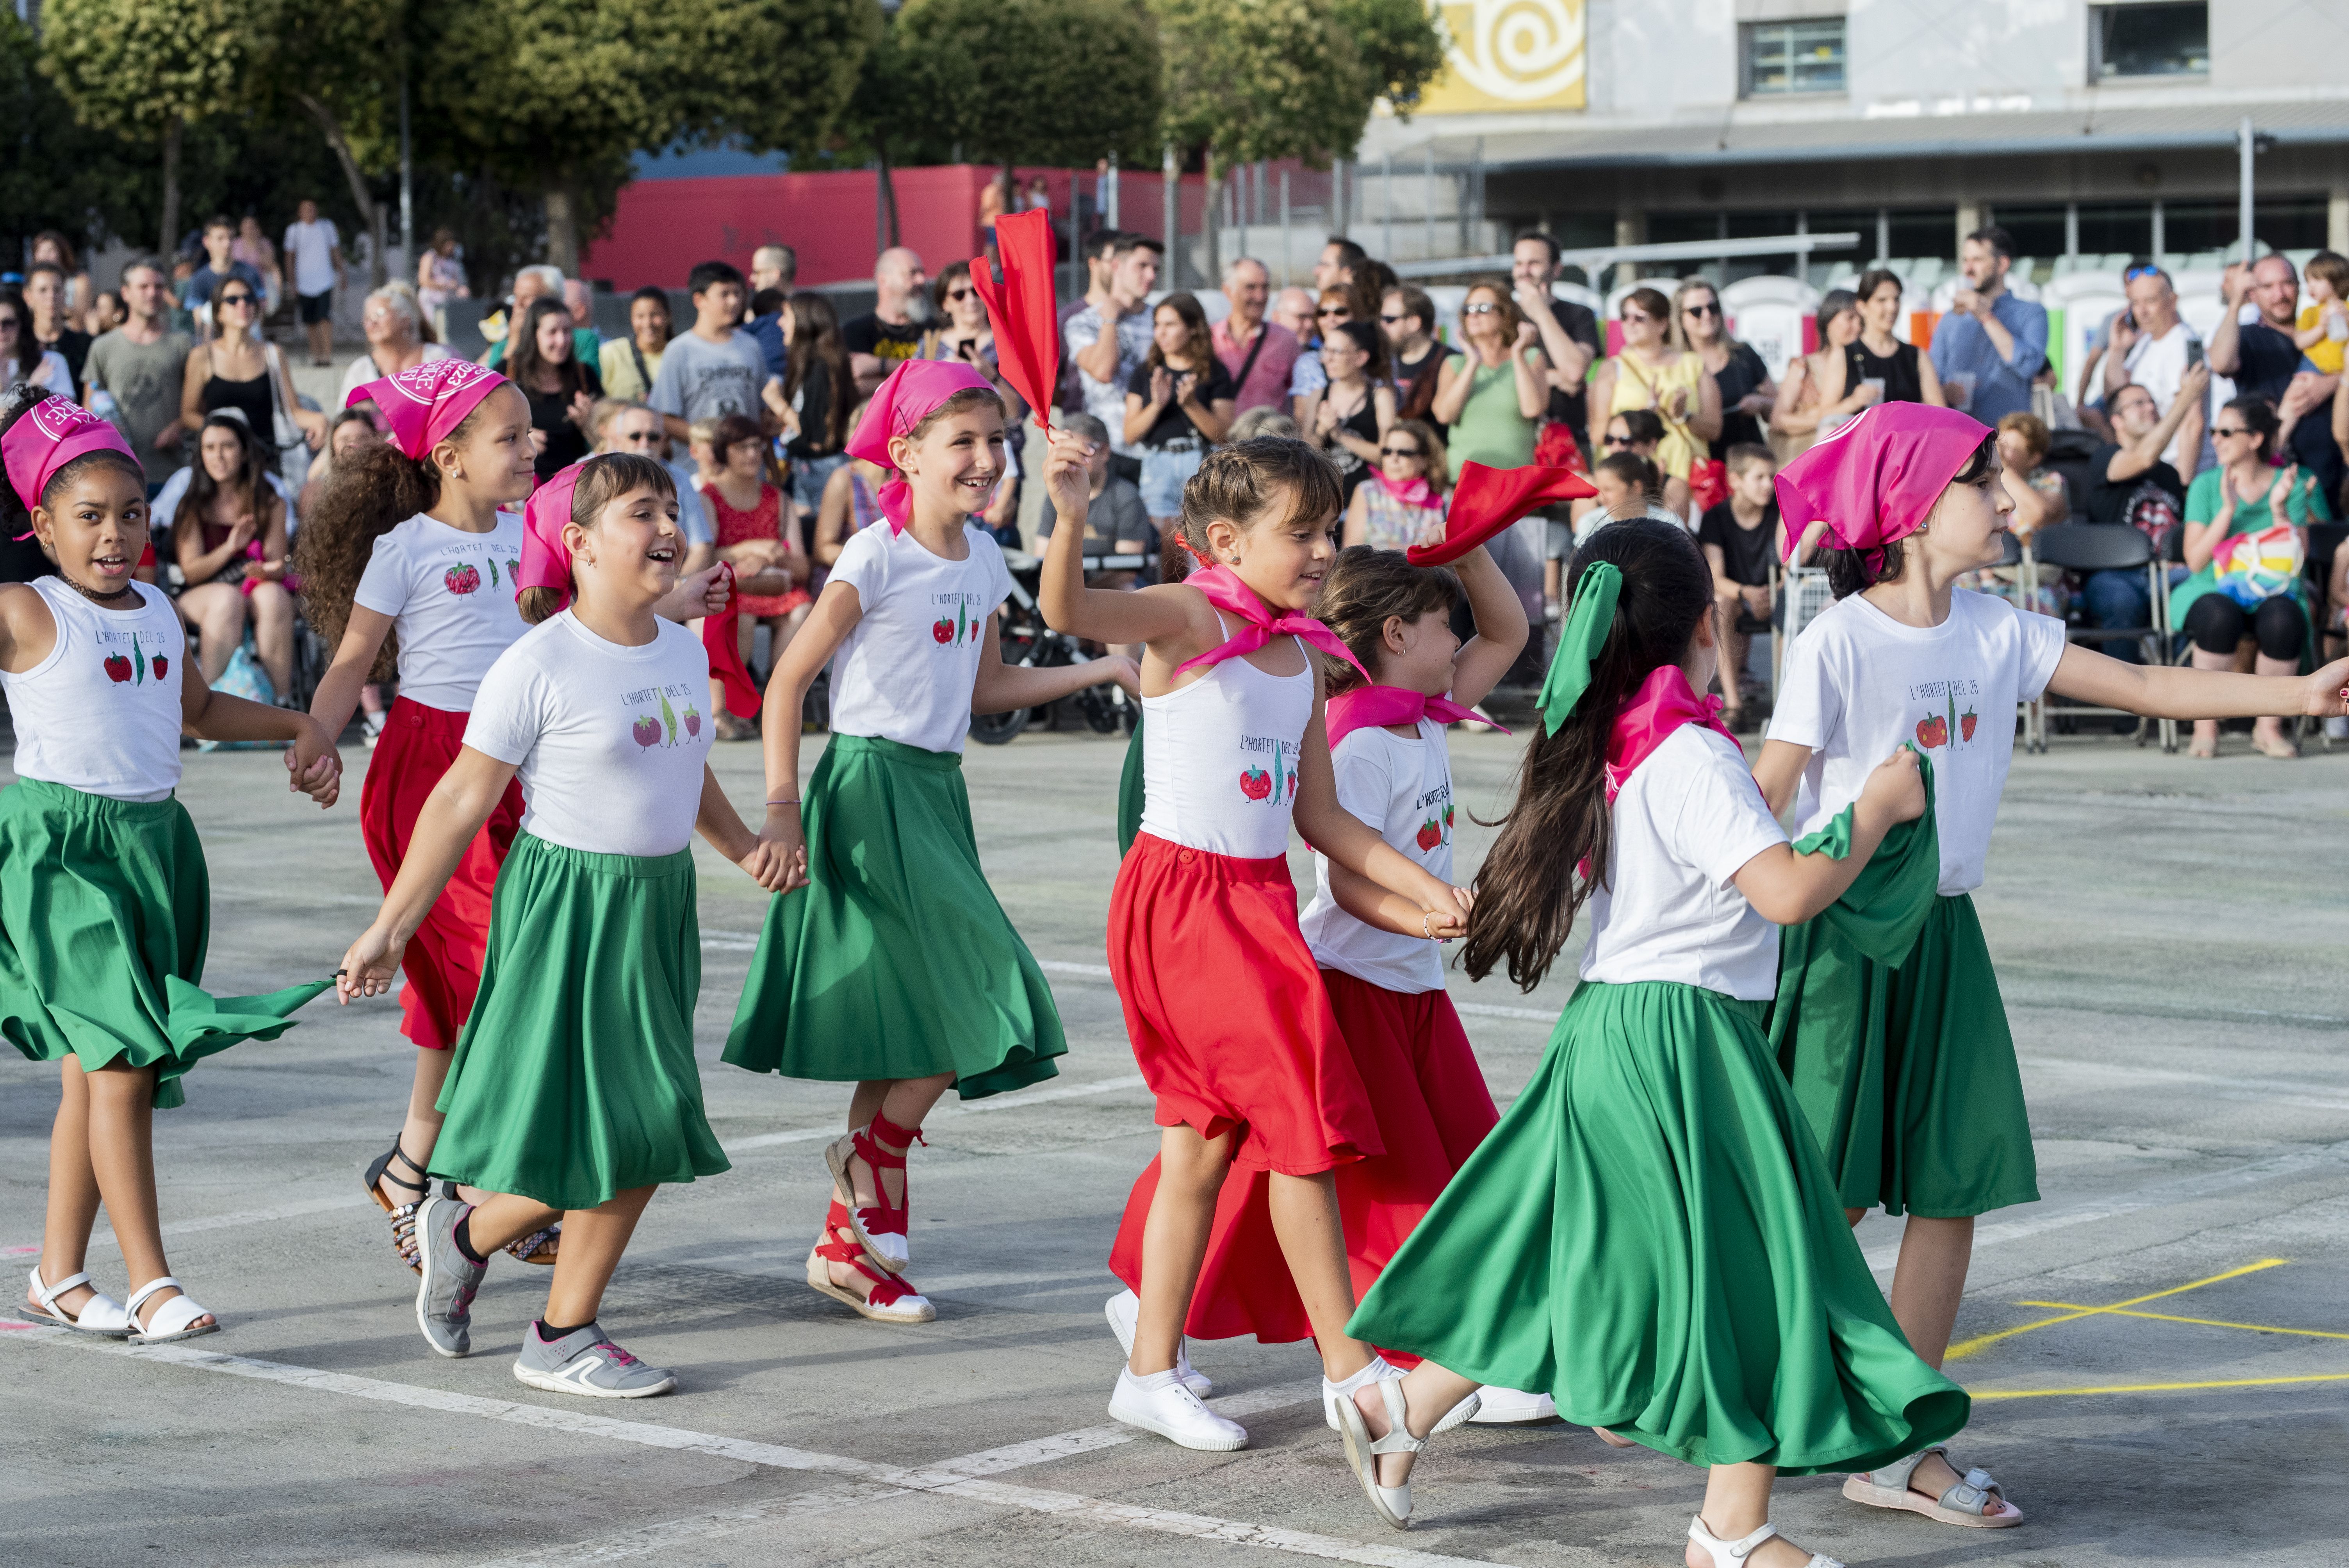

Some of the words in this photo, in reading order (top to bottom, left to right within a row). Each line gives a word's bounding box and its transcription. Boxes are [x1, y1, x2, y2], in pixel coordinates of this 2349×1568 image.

[440, 543, 482, 556] L'HORTET
[932, 593, 960, 605] L'HORTET
[96, 630, 130, 643] L'HORTET
[140, 631, 153, 643] DEL
[157, 632, 165, 643] 25
[620, 688, 657, 705] L'HORTET
[665, 684, 681, 698] DEL
[681, 683, 691, 695] 25
[1910, 681, 1946, 700] L'HORTET
[1953, 680, 1966, 696] DEL
[1969, 680, 1978, 694] 25
[1240, 734, 1274, 753] L'HORTET
[1282, 741, 1291, 755] DEL
[1417, 788, 1441, 810] L'HORTET
[1440, 784, 1449, 800] EL
